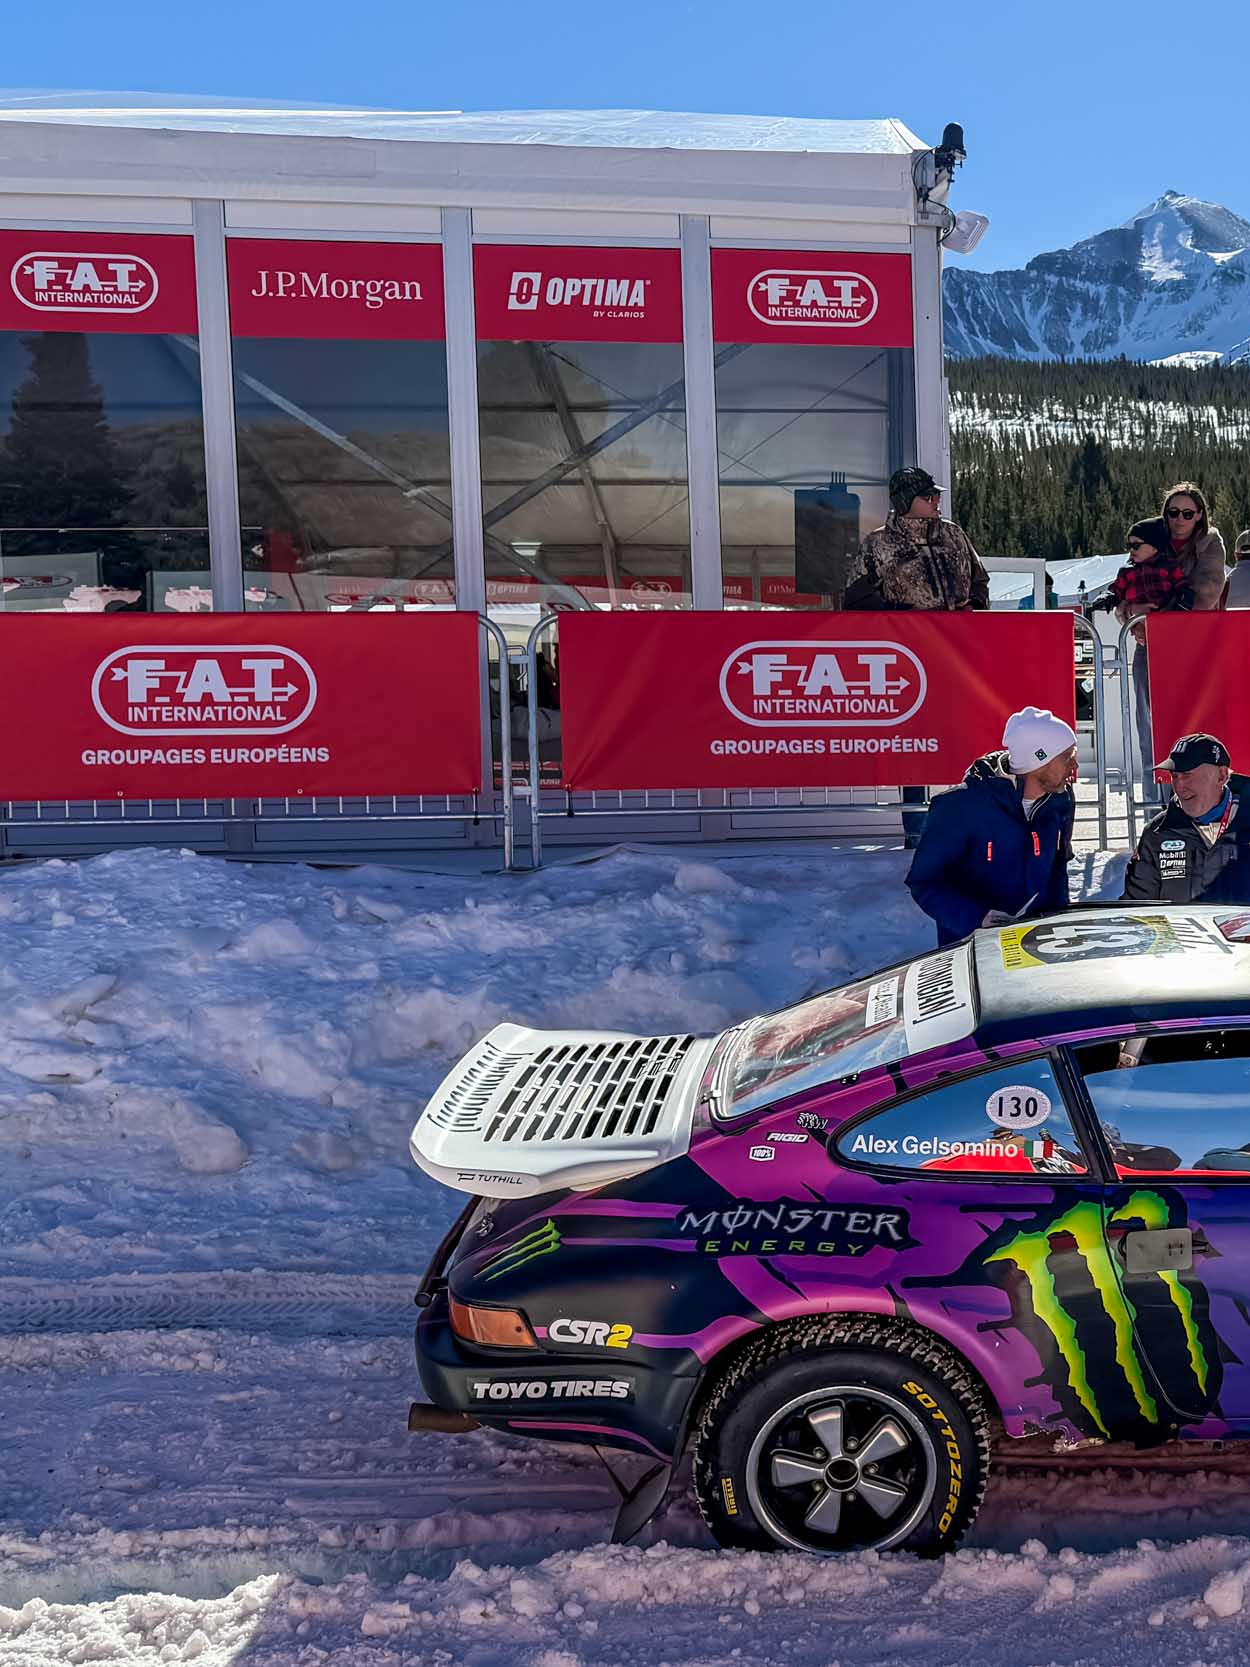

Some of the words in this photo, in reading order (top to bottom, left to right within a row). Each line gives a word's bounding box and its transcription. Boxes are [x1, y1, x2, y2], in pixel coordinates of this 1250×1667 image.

[34, 291, 140, 306] INTERNATIONAL
[251, 270, 424, 309] J.P.Morgan
[545, 277, 646, 307] OPTIMA
[593, 310, 605, 318] BY
[768, 305, 861, 320] INTERNATIONAL
[127, 705, 287, 722] INTERNATIONAL
[753, 698, 899, 714] INTERNATIONAL
[710, 738, 826, 755] GROUPAGES
[829, 735, 939, 754] EUROPÉENS
[81, 748, 206, 765] GROUPAGES
[210, 744, 330, 764] EUROPÉENS
[998, 1096, 1038, 1118] 130
[767, 1132, 809, 1143] RIGID
[852, 1135, 898, 1154] Alex
[902, 1135, 1018, 1158] Gelsomino
[753, 1149, 772, 1158] 100%
[478, 1174, 523, 1185] TUTHILL
[704, 1239, 865, 1255] ENERGY
[549, 1319, 633, 1350] CSR2
[474, 1382, 548, 1399] TOYO
[550, 1380, 630, 1398] TIRES
[902, 1381, 963, 1534] SOTTOZERO
